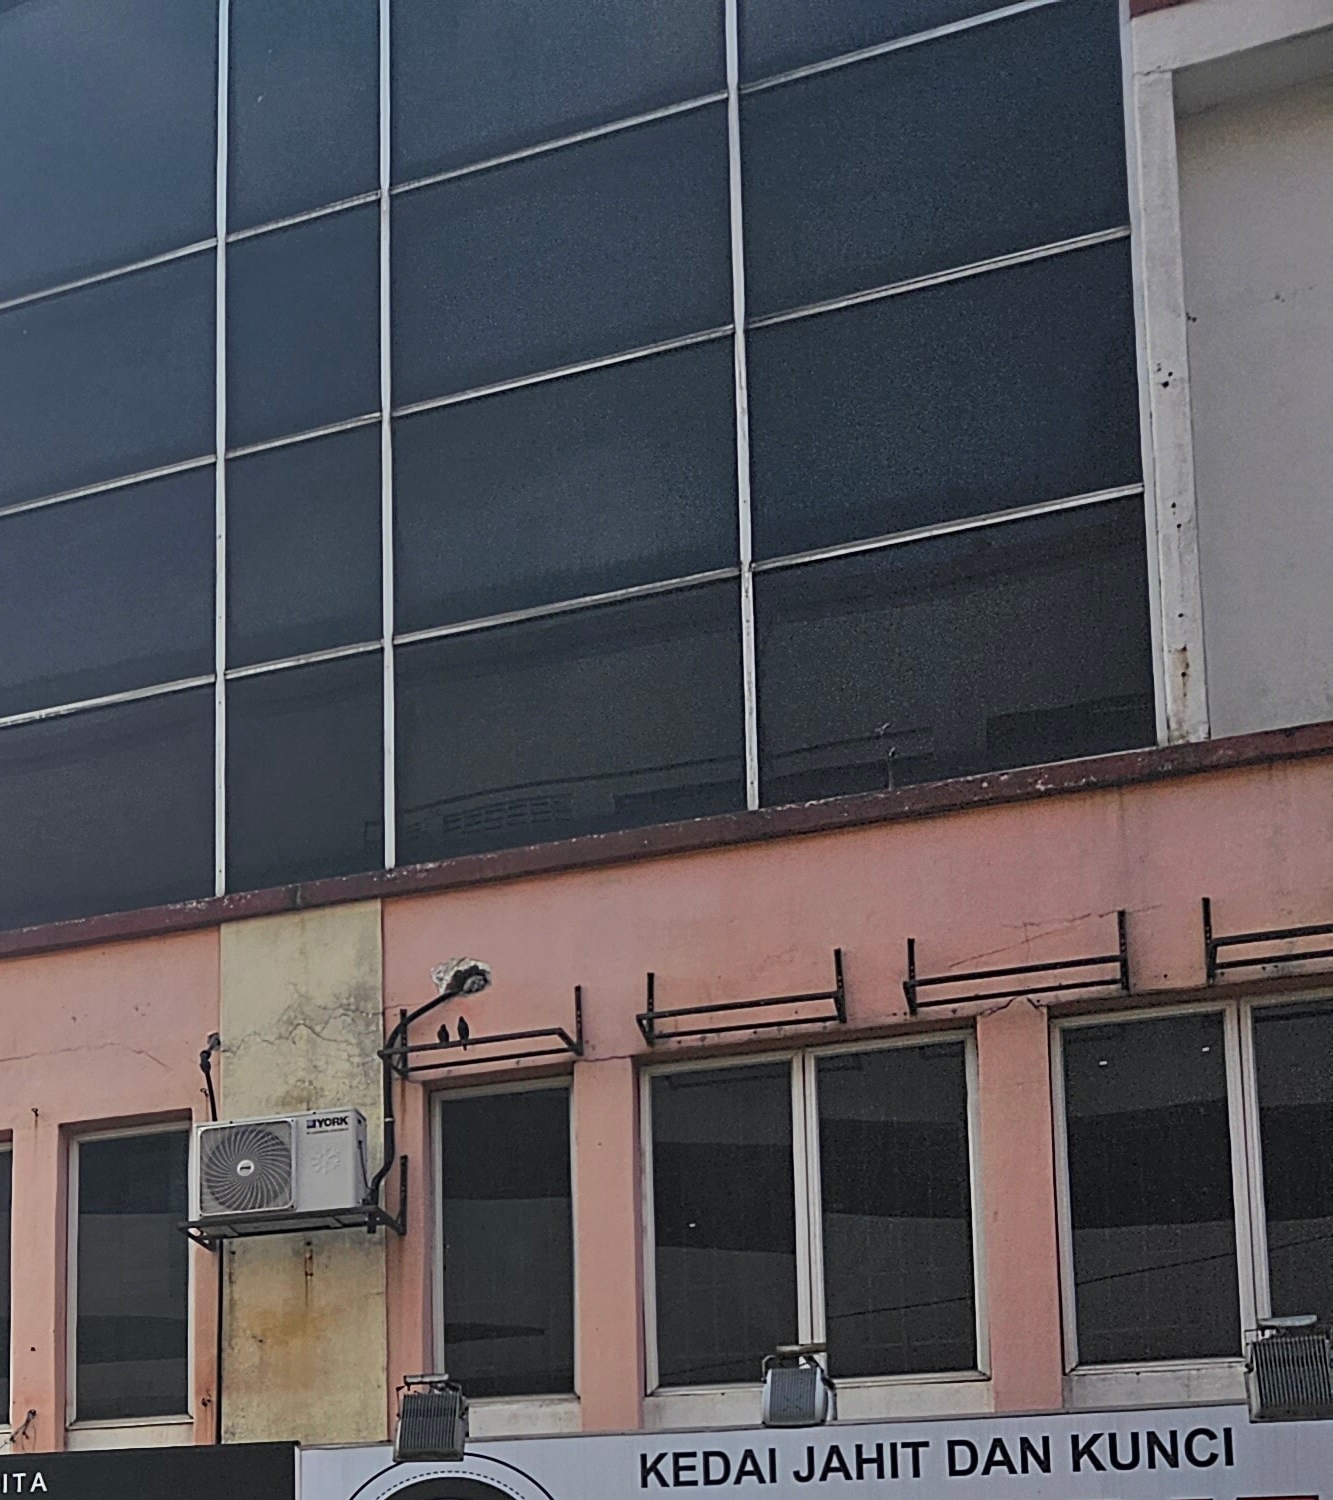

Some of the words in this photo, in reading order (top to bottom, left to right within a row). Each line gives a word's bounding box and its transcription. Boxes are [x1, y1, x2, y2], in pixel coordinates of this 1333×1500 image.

[316, 1116, 348, 1129] YORK
[640, 1448, 778, 1489] KEDAI
[792, 1440, 931, 1482] JAHIT
[946, 1435, 1053, 1478] DAN
[1070, 1427, 1235, 1474] KUNCI
